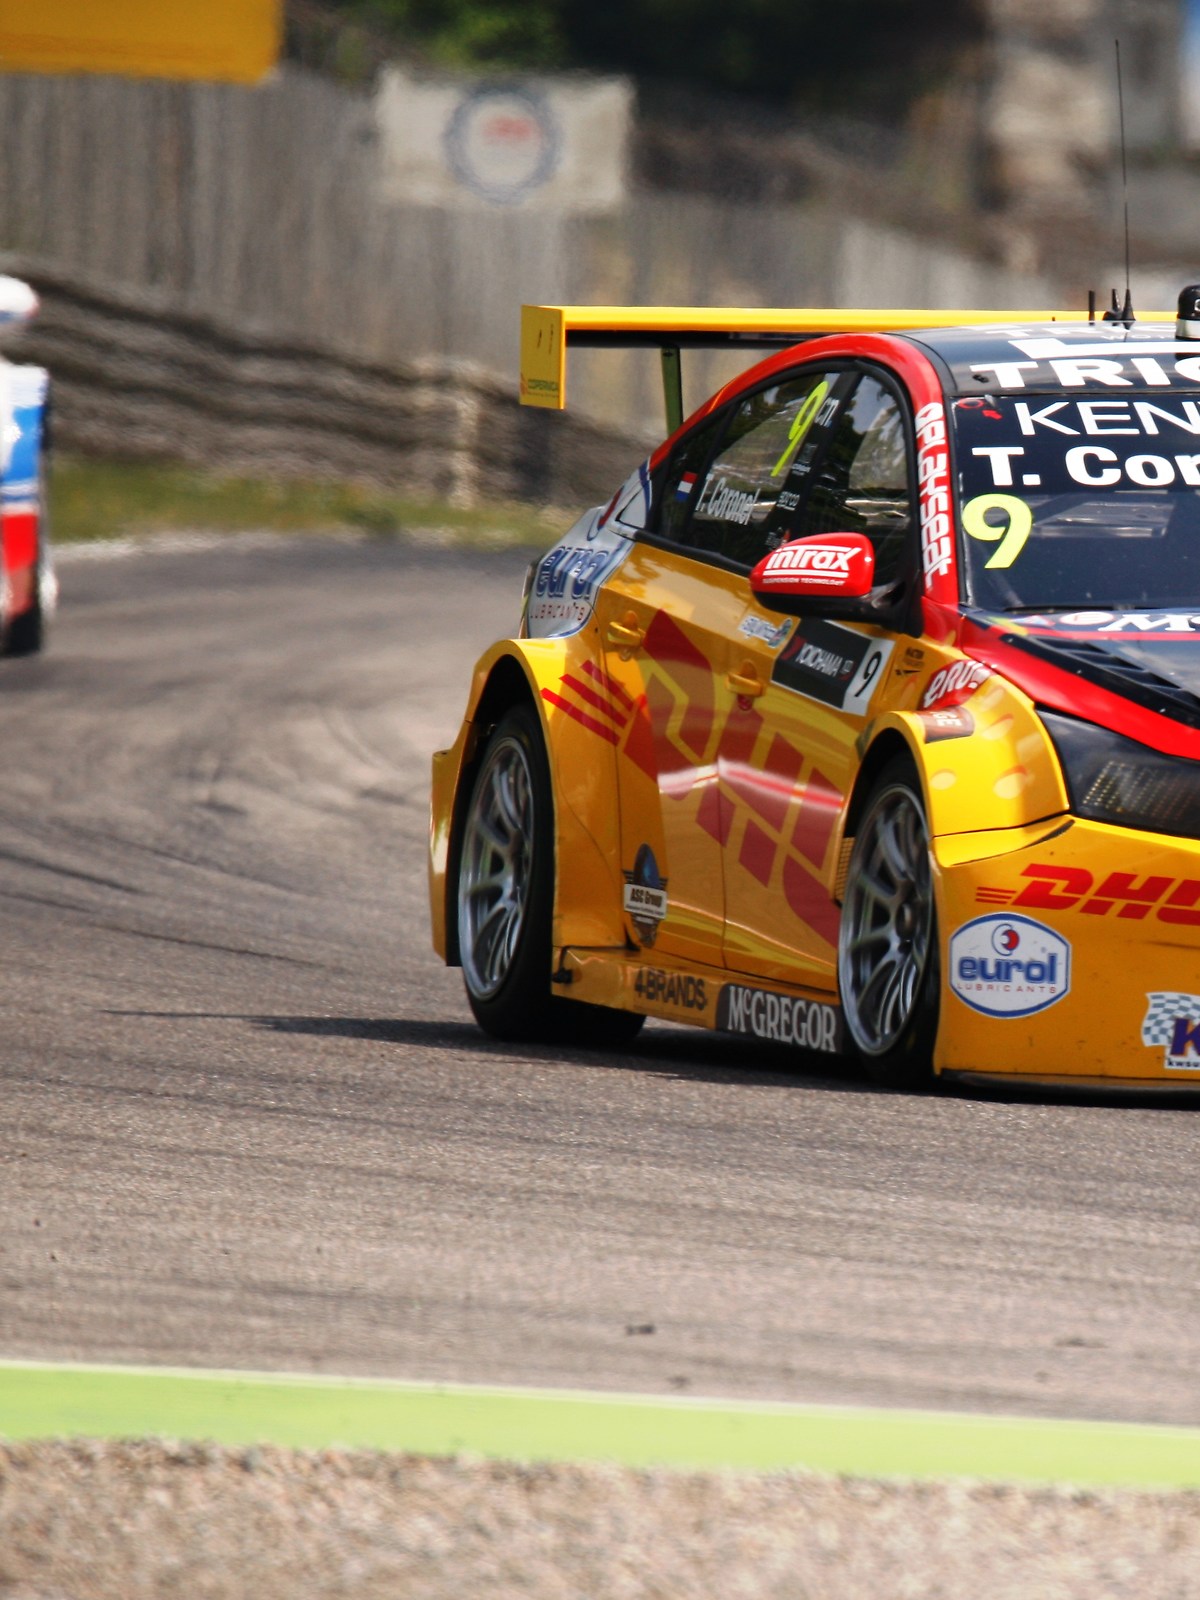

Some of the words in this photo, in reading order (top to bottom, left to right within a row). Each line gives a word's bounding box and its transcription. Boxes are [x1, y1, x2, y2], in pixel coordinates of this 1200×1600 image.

[770, 381, 829, 477] 9
[972, 446, 1041, 486] T.
[695, 473, 715, 512] T.
[707, 477, 762, 526] Coronel
[961, 493, 1033, 569] 9
[854, 651, 882, 698] 9
[956, 982, 1058, 994] LUBRICANTS
[958, 953, 1058, 985] eurol
